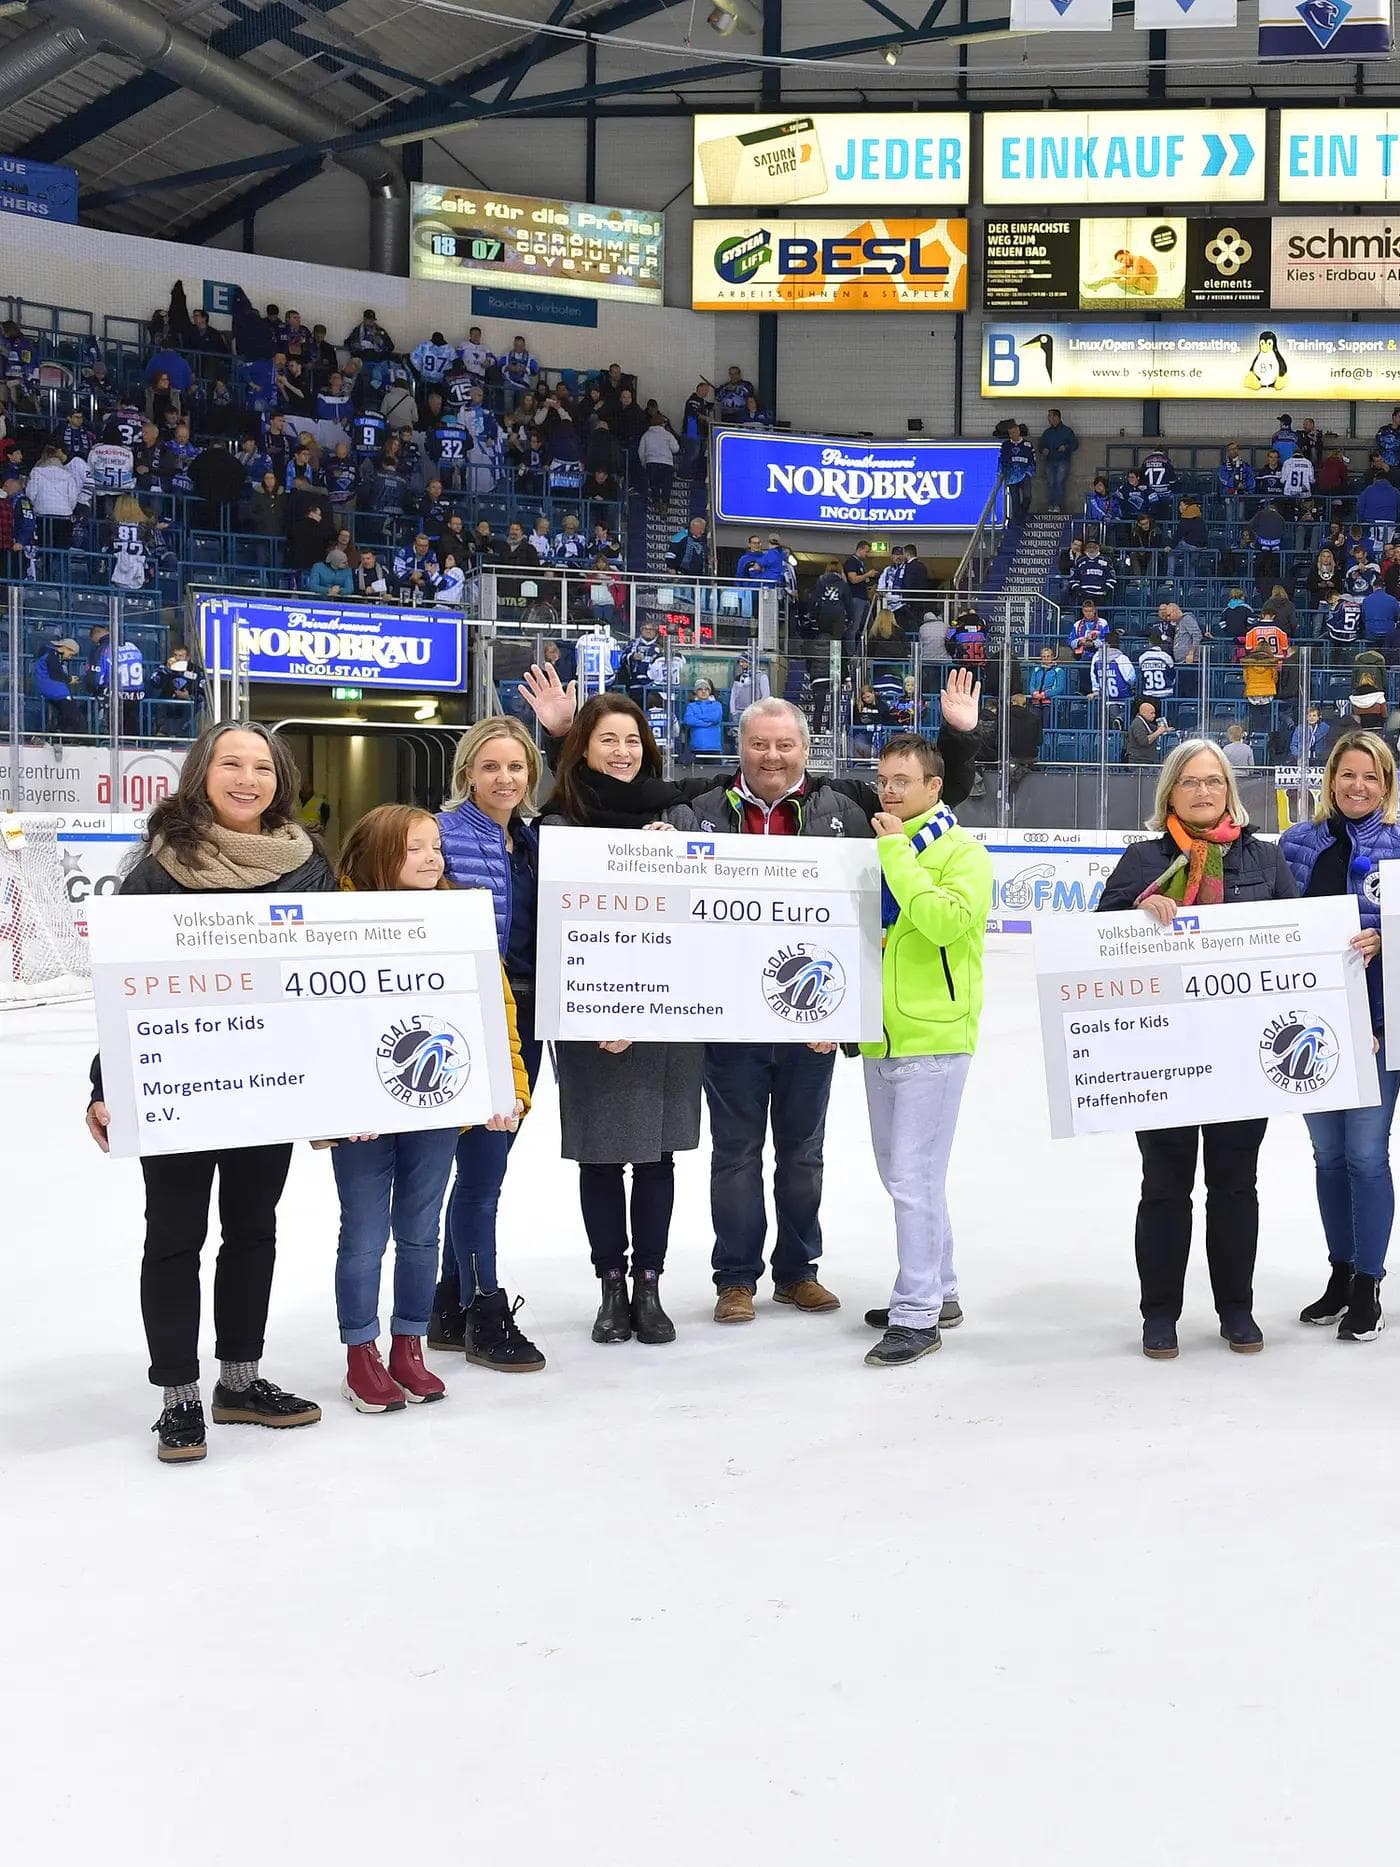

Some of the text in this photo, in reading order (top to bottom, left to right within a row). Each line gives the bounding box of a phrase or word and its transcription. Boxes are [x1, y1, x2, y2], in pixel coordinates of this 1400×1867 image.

[753, 147, 796, 167] SATURN
[836, 138, 961, 180] JEDER
[1001, 135, 1184, 179] EINKAUF
[1290, 133, 1358, 178] EIN
[768, 160, 796, 176] CARD
[423, 195, 660, 236] Zeit für die Profis!
[988, 223, 1070, 233] DER EINFACHSTE
[432, 236, 501, 260] 18 07
[516, 229, 657, 256] STRÖHMER
[722, 232, 764, 265] SYSTEM
[988, 235, 1035, 245] WEG ZUM
[516, 242, 658, 266] COMPUTER
[740, 250, 765, 271] LIFT
[778, 238, 949, 275] BESL
[988, 247, 1047, 257] NEUEN BAD
[524, 254, 650, 278] SYSTEME
[1287, 268, 1315, 281] Kies
[1326, 268, 1376, 281] Erdbau
[718, 289, 850, 297] ARBEITSBÜHNEN
[1204, 279, 1252, 288] elements
[213, 285, 228, 310] E
[488, 298, 582, 317] Rauchen verboten
[1069, 339, 1240, 353] Linux/Open Source Consulting,
[1288, 340, 1336, 353] Training,
[1338, 340, 1383, 353] Support
[1387, 340, 1396, 350] &
[424, 355, 447, 373] 97
[363, 428, 375, 445] 9
[441, 439, 463, 459] 32
[821, 449, 916, 468] Privatbrauerei
[767, 463, 964, 505] NORDBRÄU
[1291, 471, 1303, 487] 61
[820, 506, 916, 521] INGOLSTADT
[239, 627, 432, 669] NORDBRÄU
[120, 661, 144, 686] 19
[289, 663, 381, 678] INGOLSTADT
[1144, 671, 1166, 690] 39
[18, 765, 80, 780] zentrum
[71, 818, 105, 829] Audi
[1053, 834, 1080, 843] Audi
[608, 844, 673, 858] Volksbank
[608, 860, 818, 878] Raiffeisenbank Bayern Mitte eG
[561, 894, 666, 912] SPENDE
[772, 901, 830, 922] Euro
[174, 911, 254, 927] Volksbank
[176, 926, 427, 946] Raiffeisenbank Bayern Mitte eG
[568, 931, 672, 944] Goals for Kids
[1098, 924, 1161, 939] Volksbank
[1100, 930, 1301, 957] Raiffeisenbank Bayern Mitte eG
[567, 955, 584, 965] an
[124, 972, 255, 996] SPENDE
[378, 968, 445, 993] Euro
[567, 980, 669, 993] Kunstzentrum
[1060, 977, 1160, 1000] SPENDE
[1260, 970, 1317, 992] Euro
[566, 1002, 723, 1015] Besondere Menschen
[137, 1015, 265, 1036] Goals for Kids
[1070, 1015, 1169, 1034] Goals for Kids
[139, 1051, 162, 1064] an
[1073, 1047, 1089, 1058] an
[1075, 1063, 1213, 1085] Kindertrauergruppe
[143, 1070, 305, 1100] Morgentau Kinder
[1077, 1090, 1168, 1108] Pfaffenhofen
[145, 1108, 180, 1123] e.V.
